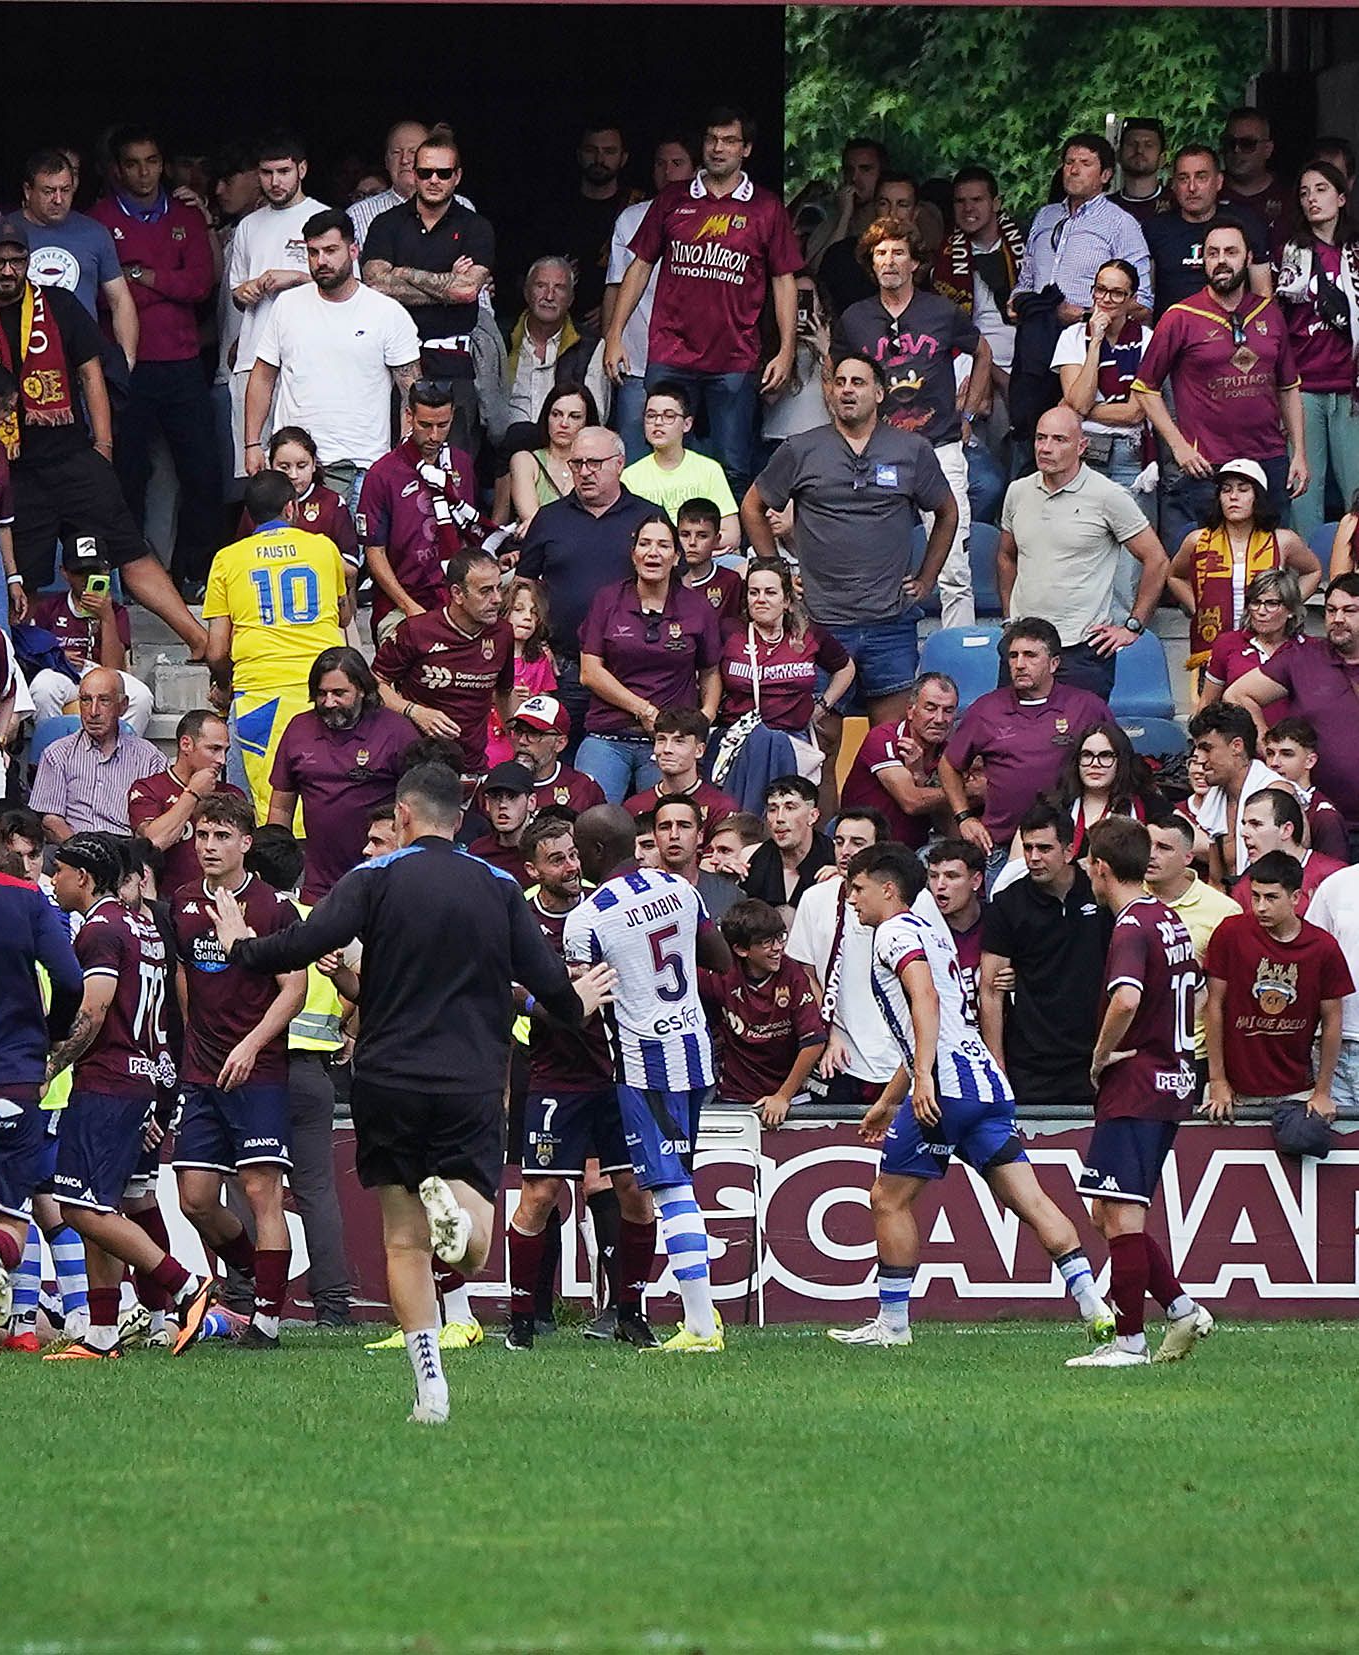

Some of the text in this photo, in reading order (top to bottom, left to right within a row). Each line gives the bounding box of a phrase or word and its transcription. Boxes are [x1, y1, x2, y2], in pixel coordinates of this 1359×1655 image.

[256, 544, 297, 558] FAUSTO
[250, 565, 320, 625] 10
[624, 908, 644, 928] JC
[645, 920, 687, 1005] 5
[1235, 1015, 1255, 1030] HAI
[541, 1098, 559, 1132] 7
